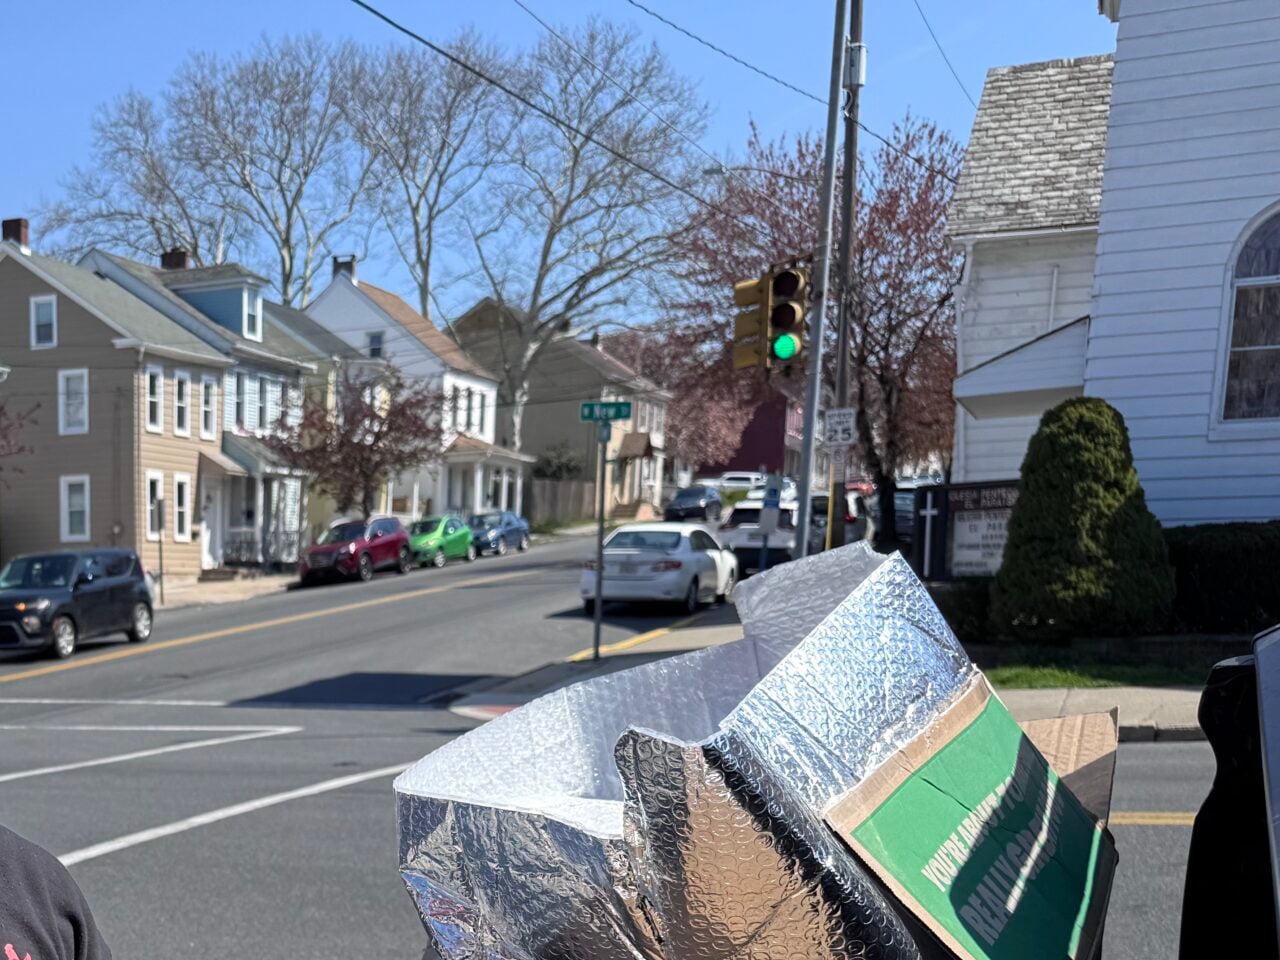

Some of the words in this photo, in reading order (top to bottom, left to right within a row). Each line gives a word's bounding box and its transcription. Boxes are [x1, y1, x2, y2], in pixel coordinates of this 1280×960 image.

[827, 428, 852, 442] 25
[921, 831, 970, 893] YOU'RE
[957, 792, 1005, 853] ABOUT
[959, 854, 1027, 947] REALLY
